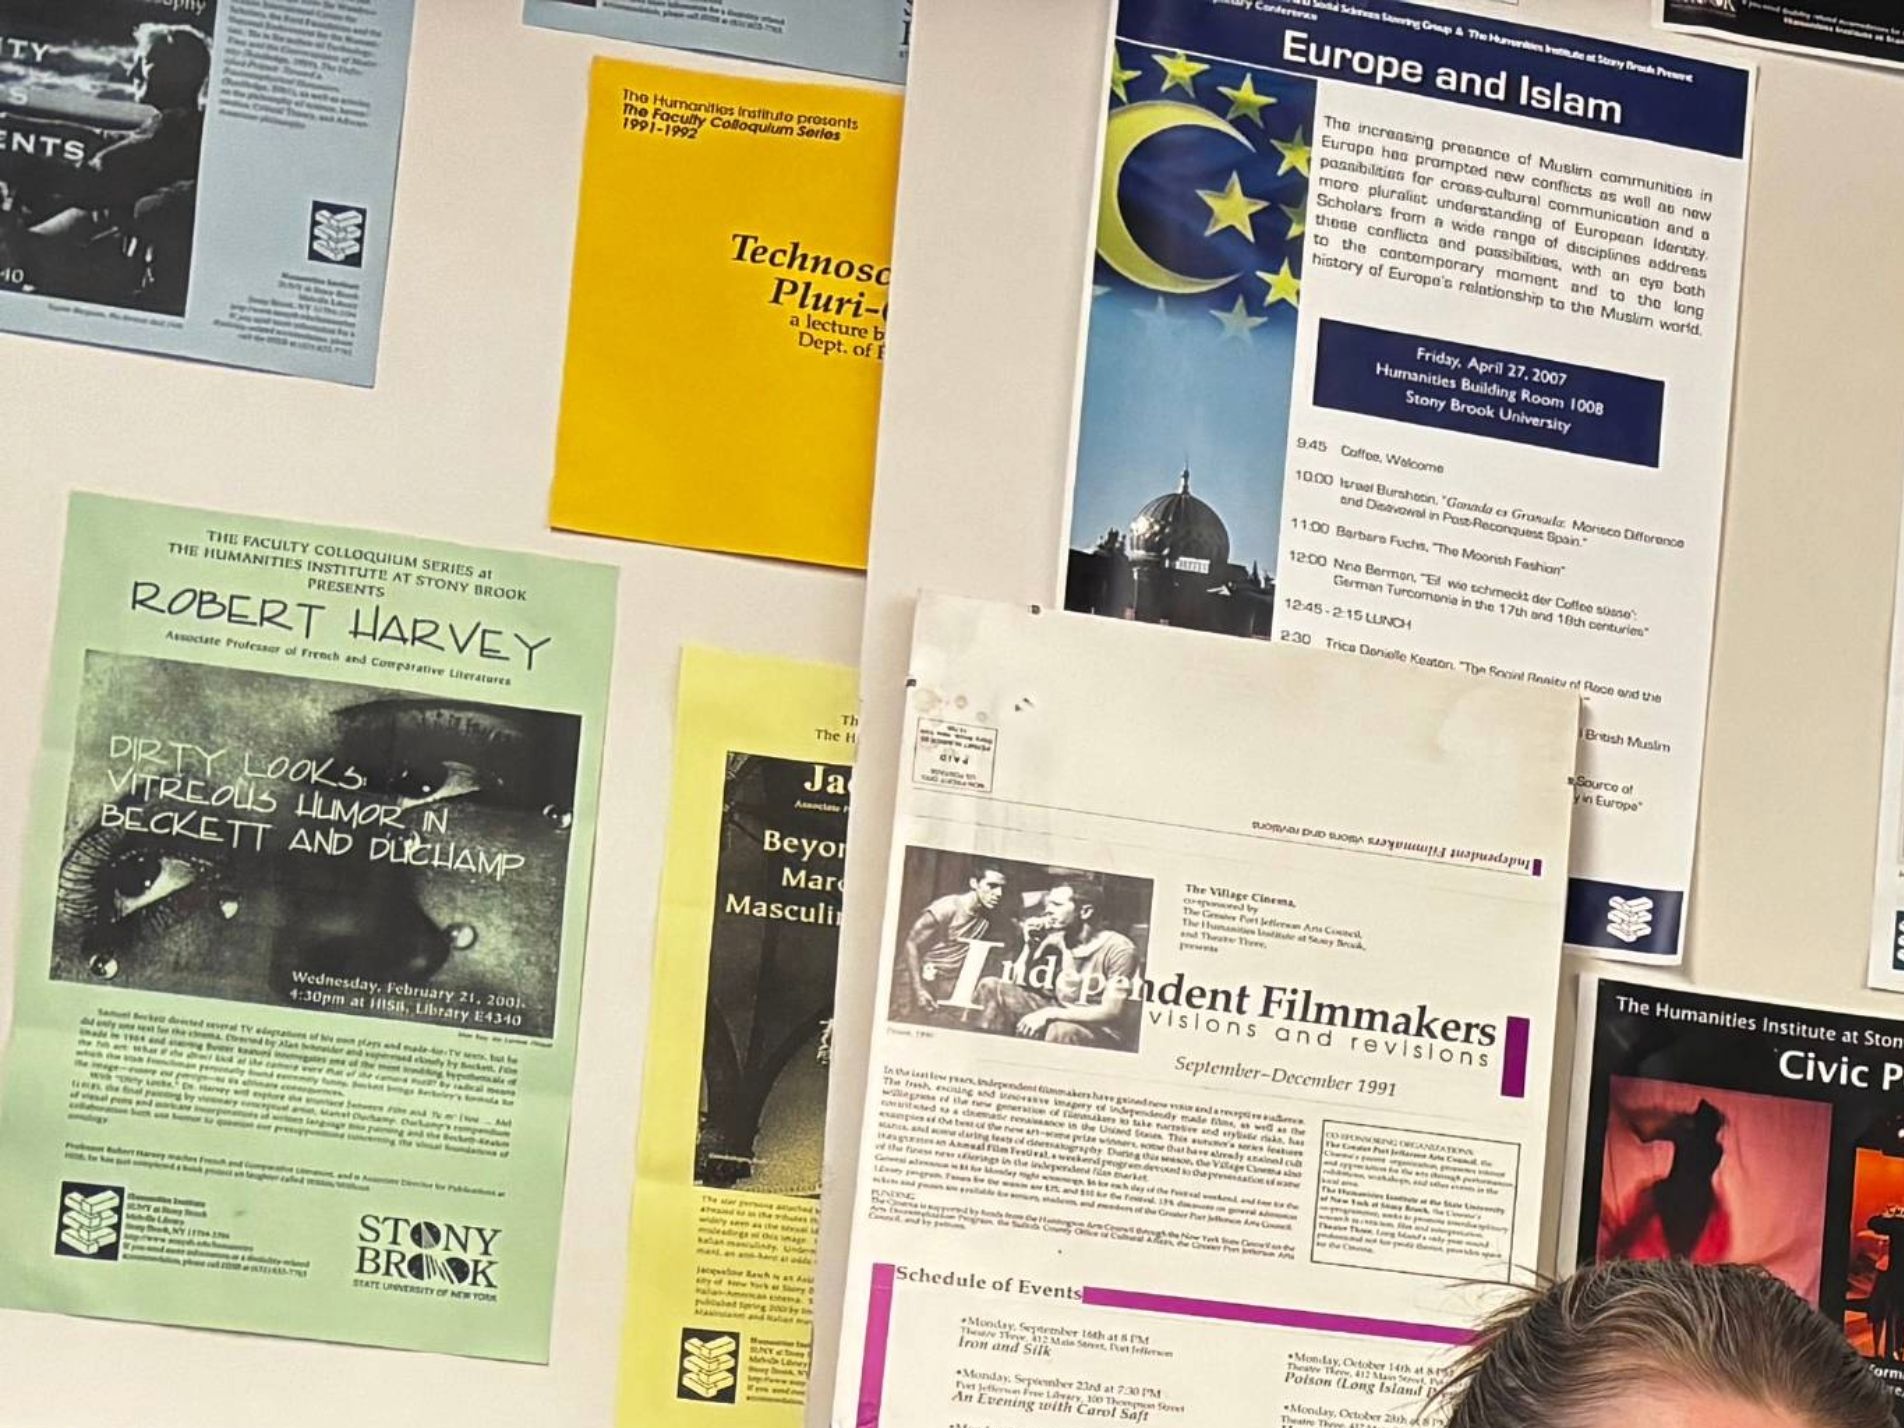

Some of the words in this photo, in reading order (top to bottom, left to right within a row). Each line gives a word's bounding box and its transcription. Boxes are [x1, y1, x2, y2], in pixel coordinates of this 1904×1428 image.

[1282, 29, 1423, 85] Europe
[1435, 67, 1507, 101] and
[1519, 74, 1622, 124] Islam
[623, 88, 649, 104] The
[653, 94, 735, 116] Humanities
[738, 106, 794, 123] Institute
[797, 114, 859, 131] presents
[1416, 346, 1462, 370] Friday,
[1467, 356, 1504, 375] April
[1507, 363, 1529, 381] 27,
[1532, 367, 1568, 386] 2007
[1405, 389, 1447, 412] Stony
[1450, 397, 1495, 418] Brook
[1498, 407, 1572, 435] University
[207, 530, 238, 546] THE
[243, 535, 310, 554] FACULTY
[314, 544, 418, 568] COLLOQUIUM
[421, 558, 474, 577] SERIES
[477, 569, 492, 580] at
[131, 580, 326, 640] ROBERT
[348, 604, 552, 671] HARVEY
[108, 768, 277, 813] VITREOUS
[295, 791, 405, 829] HUMOR
[422, 810, 448, 834] IN
[101, 804, 273, 851] BECKETT
[289, 830, 352, 855] AND
[370, 837, 526, 880] DUCHAMP
[939, 937, 1252, 1016] Independent
[1258, 985, 1496, 1047] Filmmakers
[1149, 1009, 1256, 1038] visions
[1275, 1027, 1332, 1047] and
[1350, 1036, 1489, 1067] revisions
[359, 1214, 502, 1257] STONY
[356, 1246, 498, 1288] BROOK
[895, 1264, 987, 1292] Schedule
[991, 1277, 1014, 1293] of
[1018, 1279, 1083, 1304] Events
